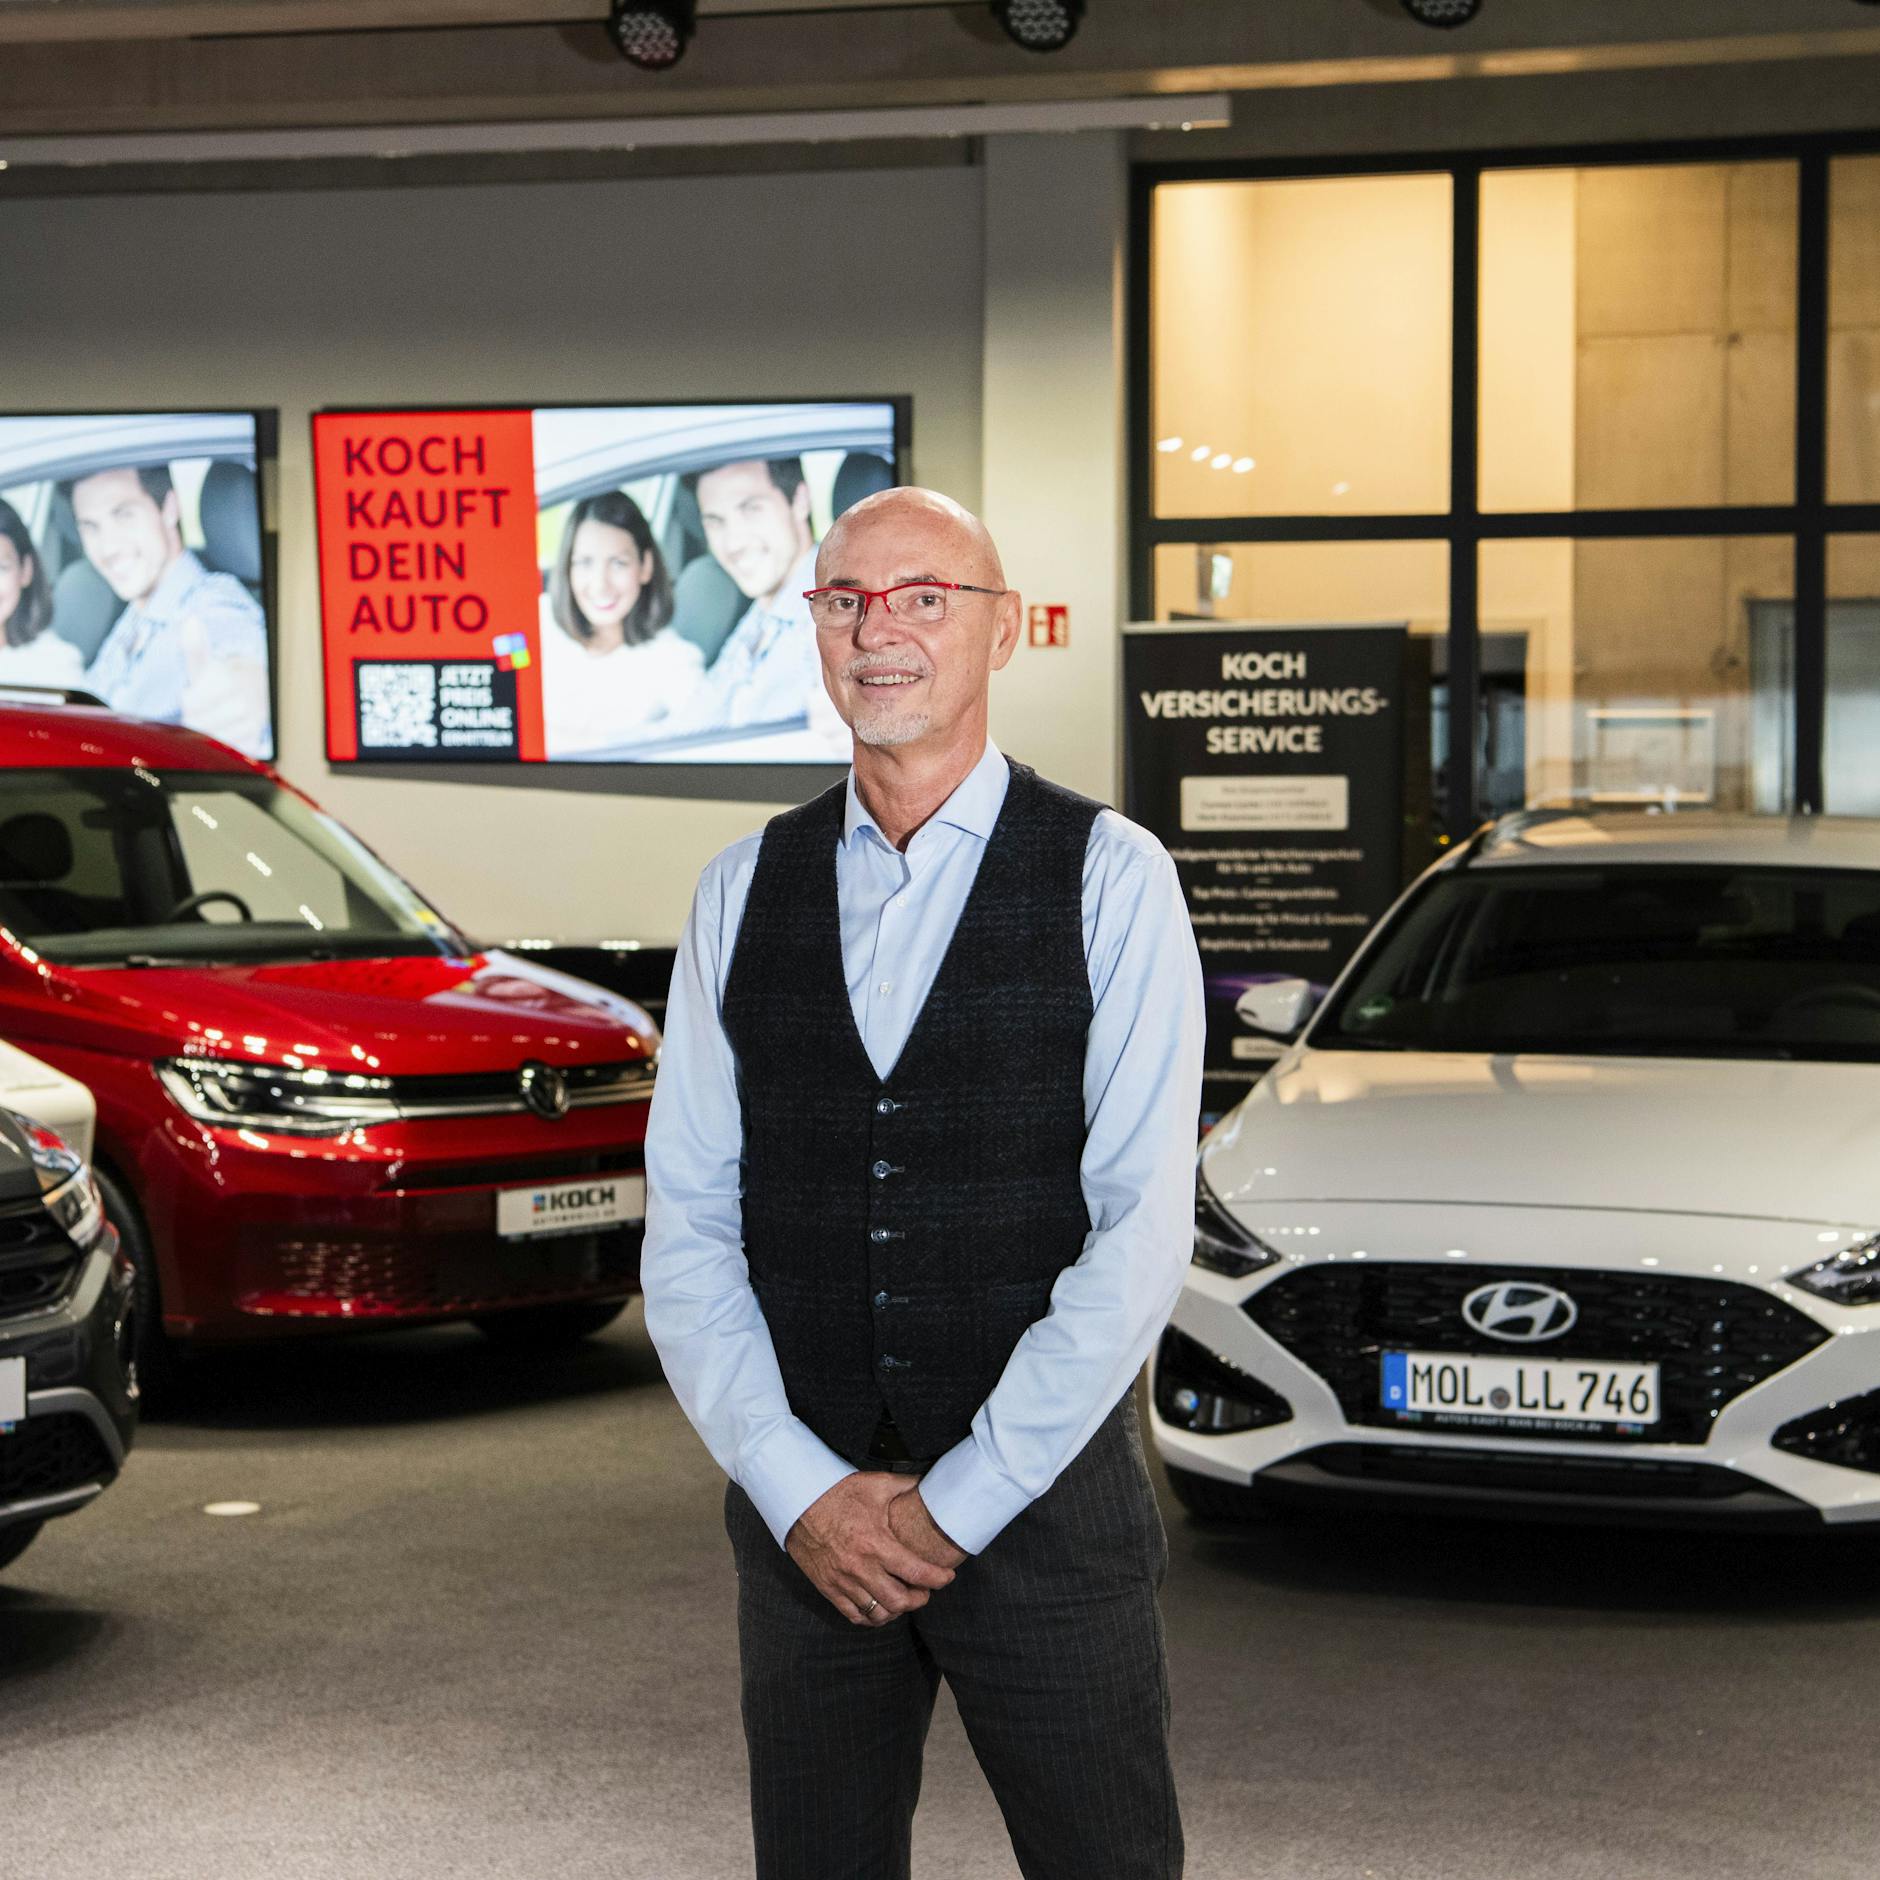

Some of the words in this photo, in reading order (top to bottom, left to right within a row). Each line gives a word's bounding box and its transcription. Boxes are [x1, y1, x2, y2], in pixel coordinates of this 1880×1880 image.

[344, 435, 486, 477] KOCH
[347, 488, 511, 530] KAUFT
[350, 542, 466, 582] DEIN
[350, 593, 490, 635] AUTO
[438, 664, 494, 687] JETZT
[1220, 651, 1307, 681] KOCH
[439, 686, 493, 707] PREIS
[1140, 687, 1389, 719] VERSICHERUNGS-
[439, 706, 513, 730] ONLINE
[1205, 725, 1323, 755] SERVICE
[551, 1186, 615, 1210] KOCH
[1410, 1363, 1483, 1406] MOL
[1517, 1368, 1565, 1411] LL
[1577, 1371, 1651, 1416] 746
